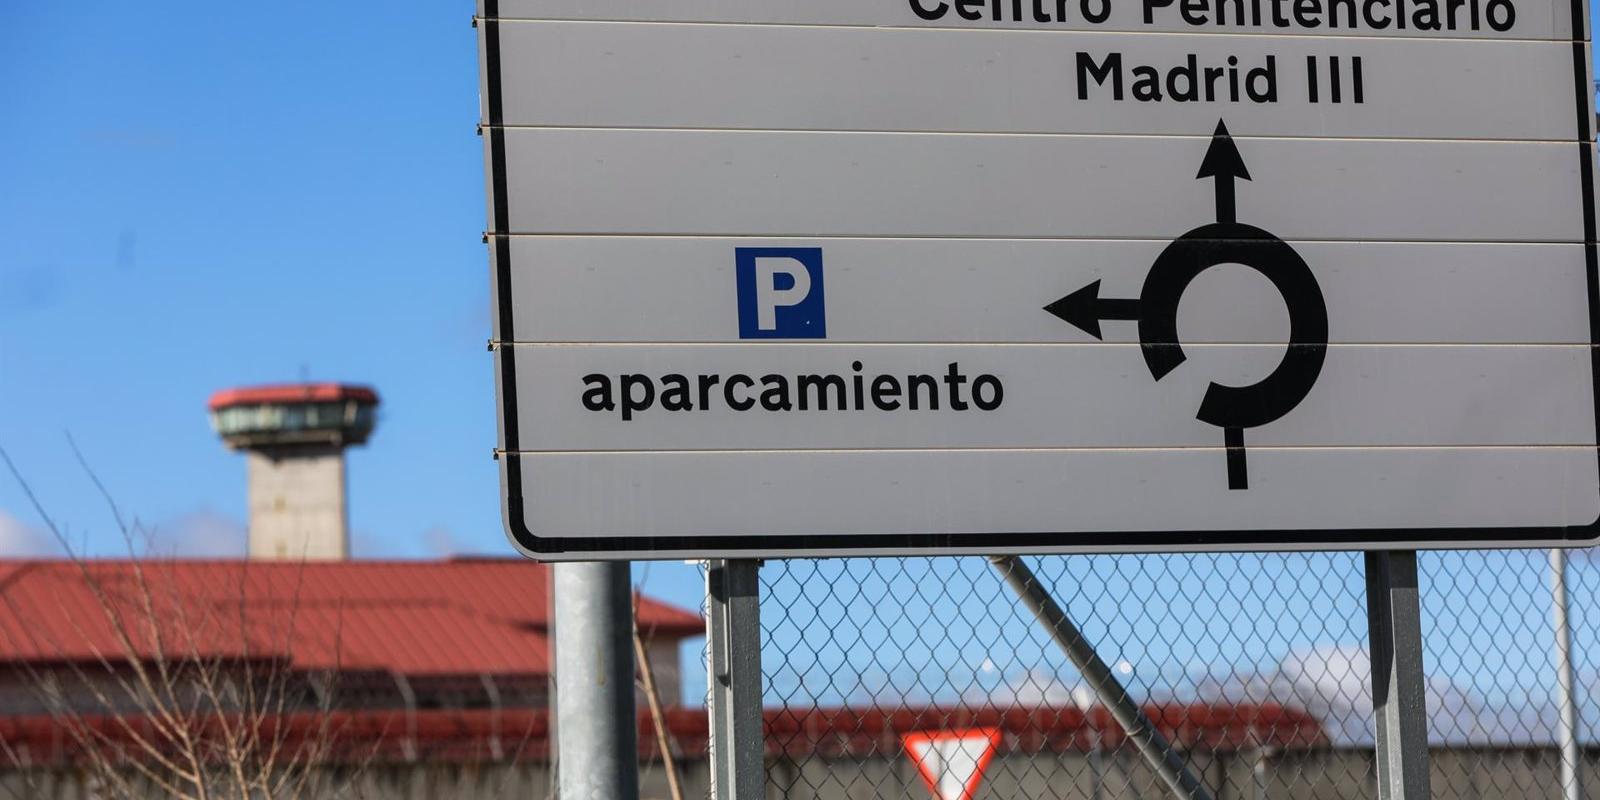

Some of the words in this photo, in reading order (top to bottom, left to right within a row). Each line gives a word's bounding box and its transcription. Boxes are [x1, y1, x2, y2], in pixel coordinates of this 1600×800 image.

[1075, 52, 1278, 104] Madrid
[1306, 55, 1364, 104] III
[755, 257, 811, 330] P
[581, 360, 1004, 422] aparcamiento
